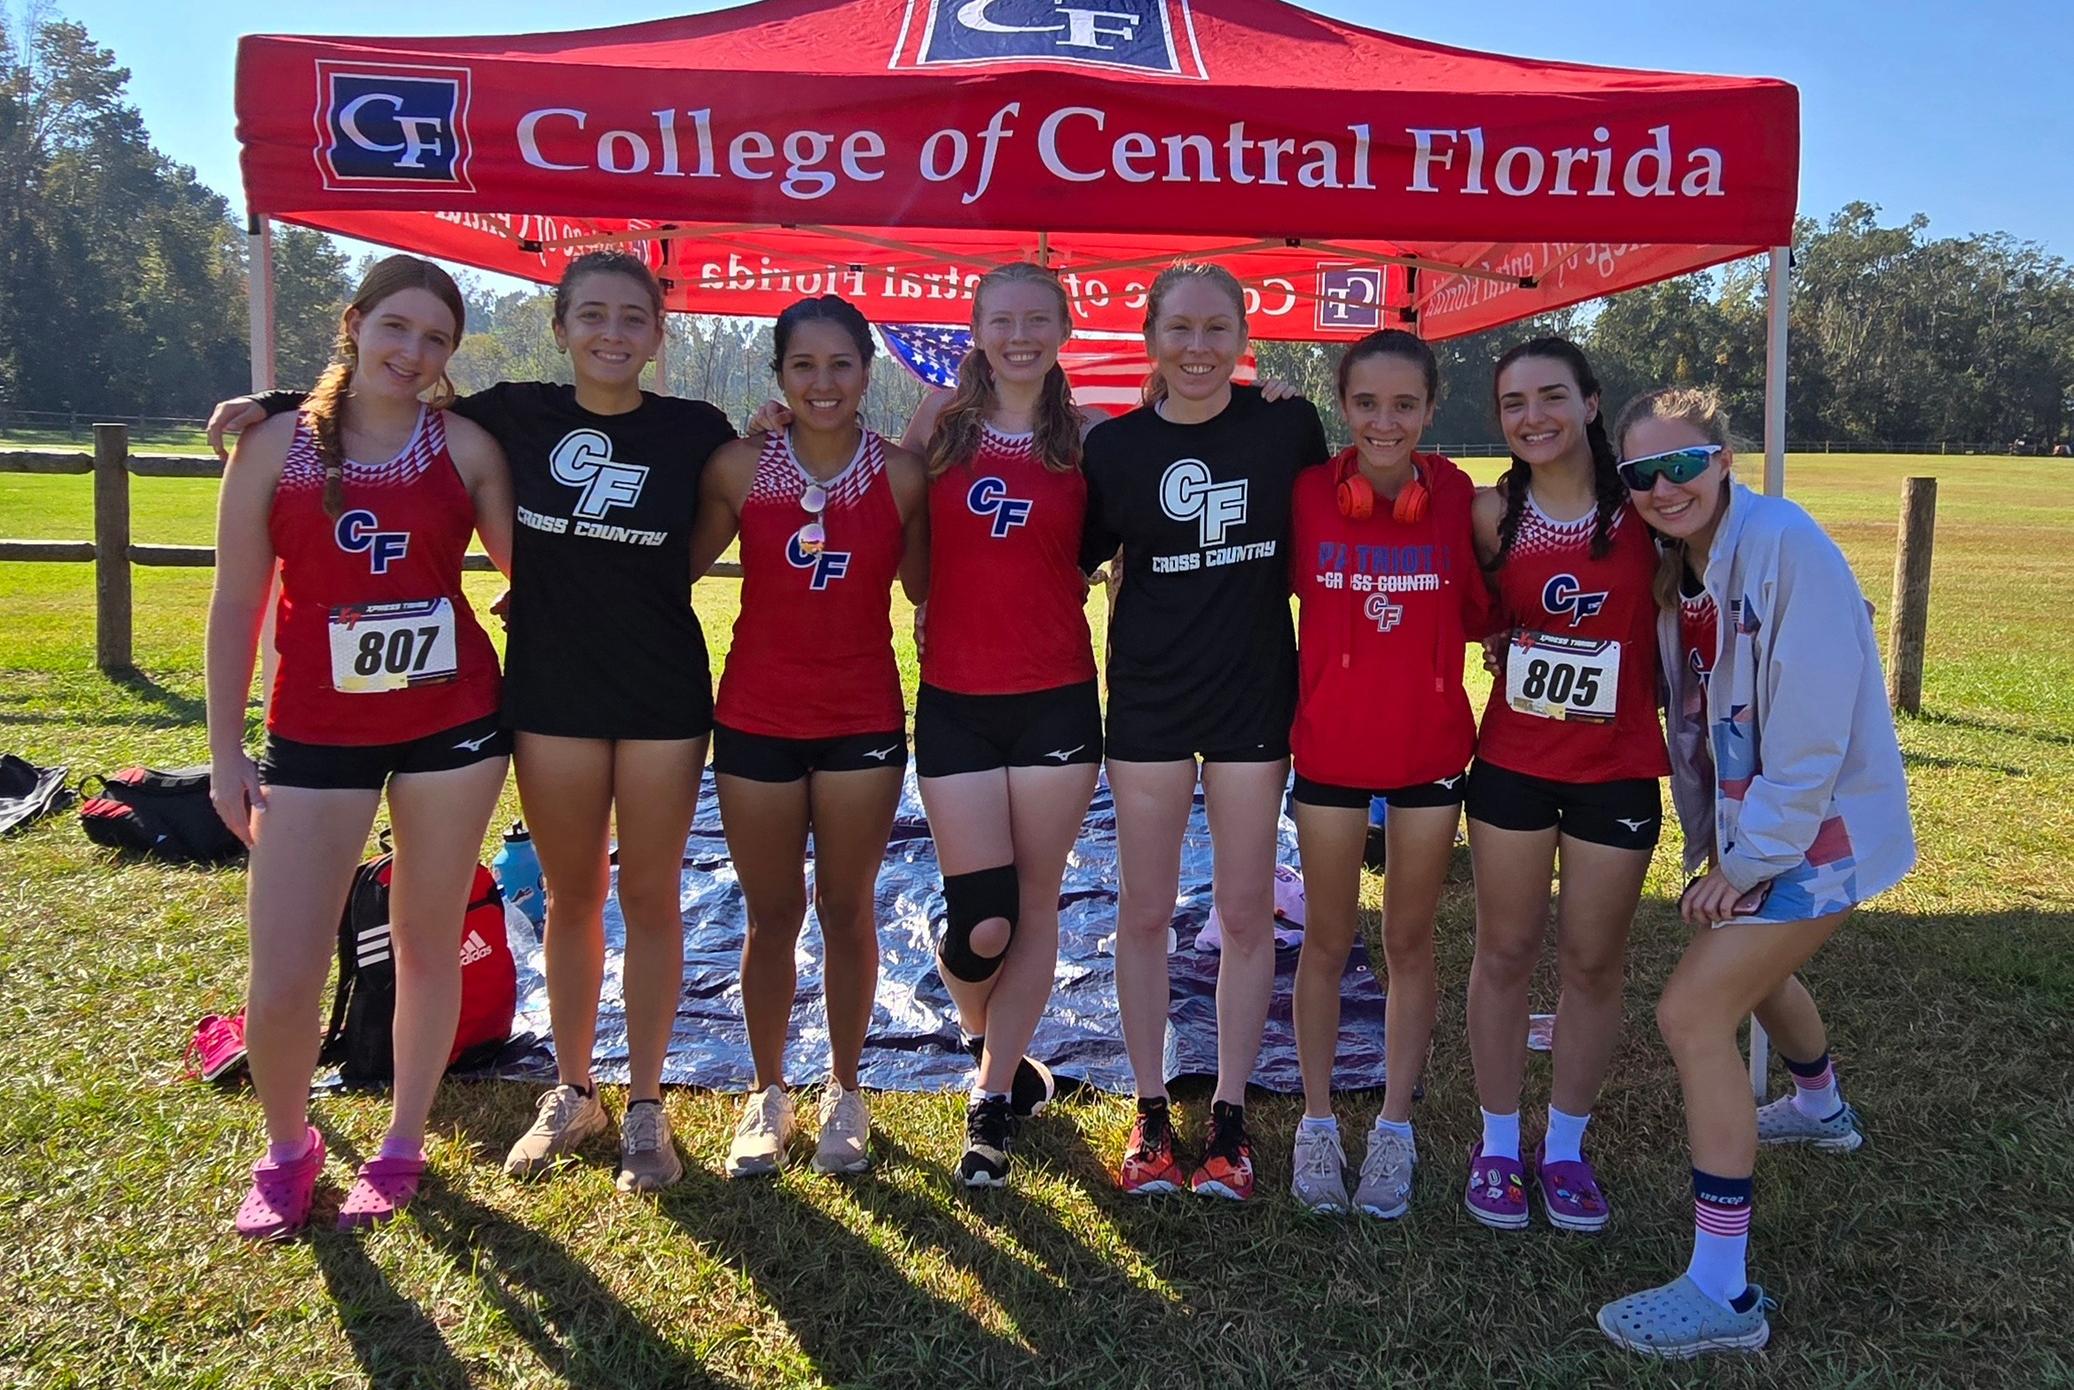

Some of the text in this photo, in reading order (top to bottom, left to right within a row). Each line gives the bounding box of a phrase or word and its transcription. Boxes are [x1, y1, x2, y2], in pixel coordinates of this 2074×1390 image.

[957, 0, 1140, 50] CF
[339, 94, 442, 168] CF
[516, 102, 1726, 204] College of Central Florida
[550, 428, 650, 519] CF
[517, 506, 668, 546] CROSS COUNTRY
[967, 477, 1033, 538] CF
[1159, 458, 1248, 548] CF
[335, 509, 410, 574] CF
[1152, 540, 1276, 573] CROSS COUNTRY
[1325, 572, 1372, 591] CRSS
[1542, 573, 1609, 627] CF
[1364, 592, 1403, 632] CF
[354, 625, 440, 676] 807
[1522, 659, 1603, 707] 805
